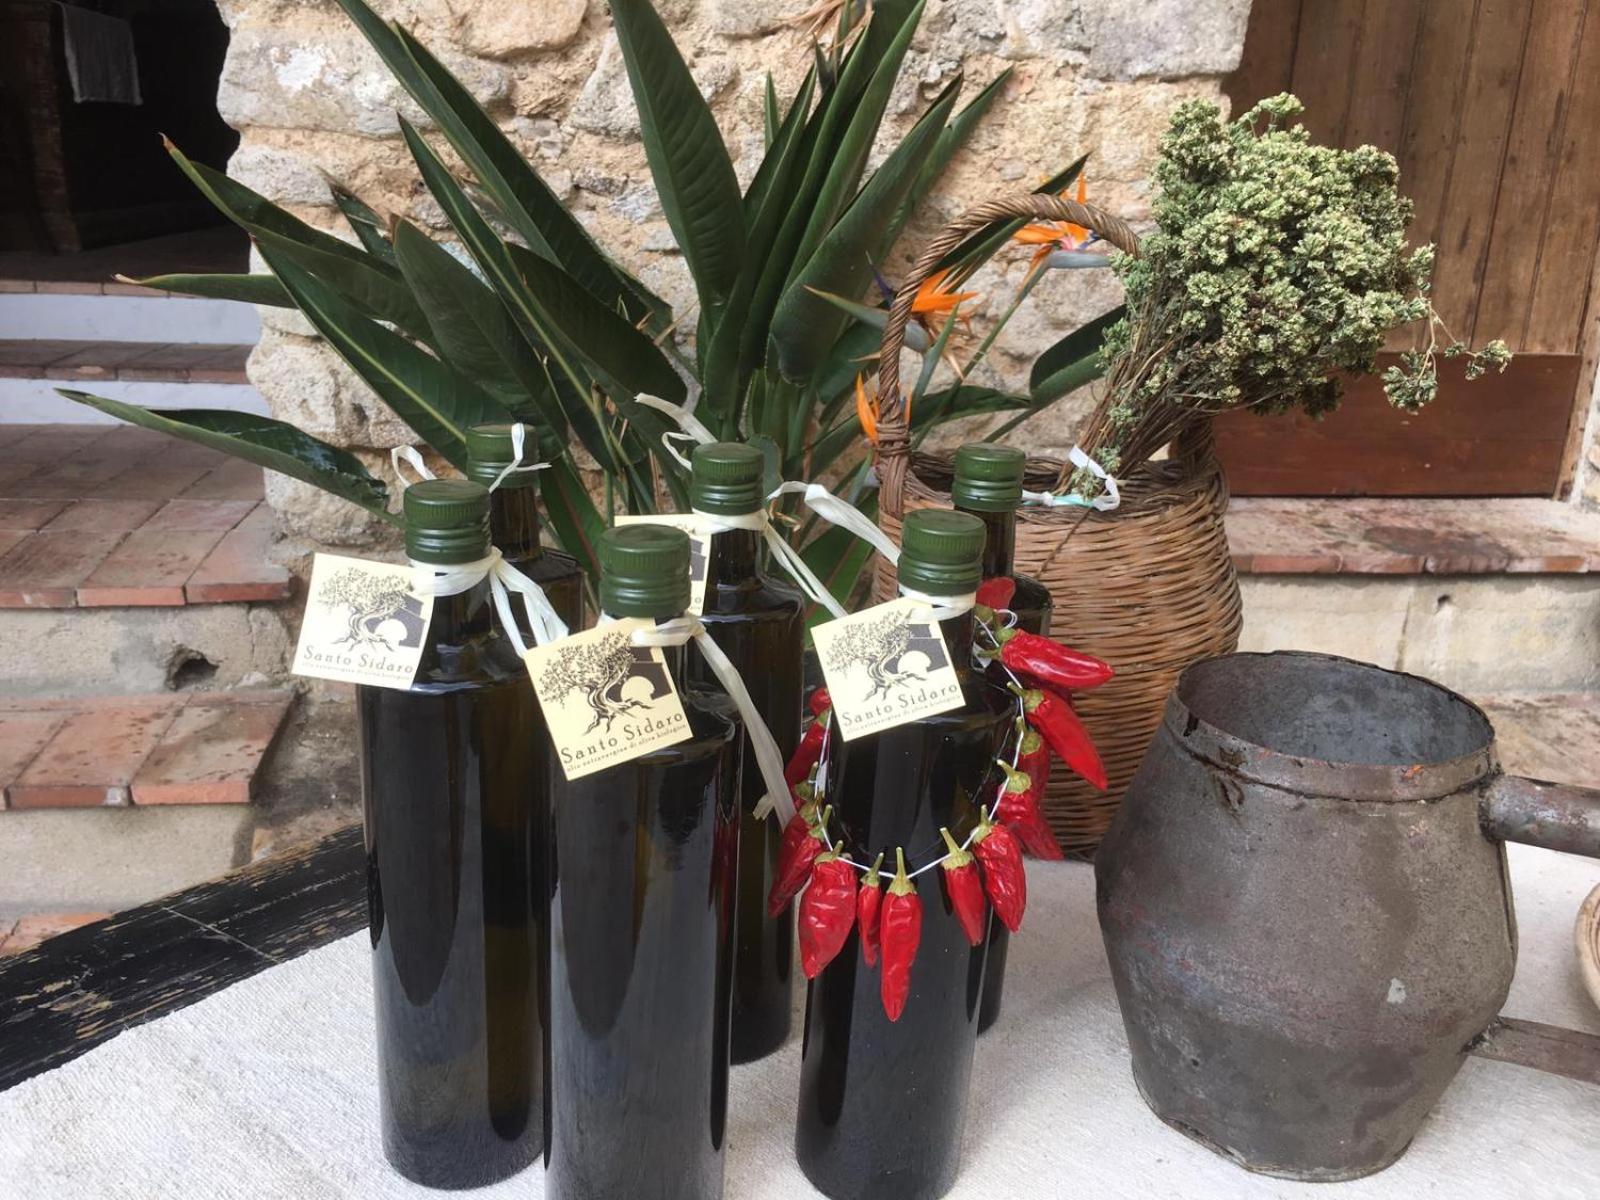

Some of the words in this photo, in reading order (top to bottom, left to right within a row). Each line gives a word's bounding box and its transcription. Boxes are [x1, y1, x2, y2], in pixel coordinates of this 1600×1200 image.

[303, 645, 352, 666] Santo
[358, 652, 414, 674] Sidaro
[842, 703, 893, 727] Santo
[898, 683, 958, 709] Sidaro
[560, 738, 618, 764] Santo
[623, 713, 683, 741] Sidaro
